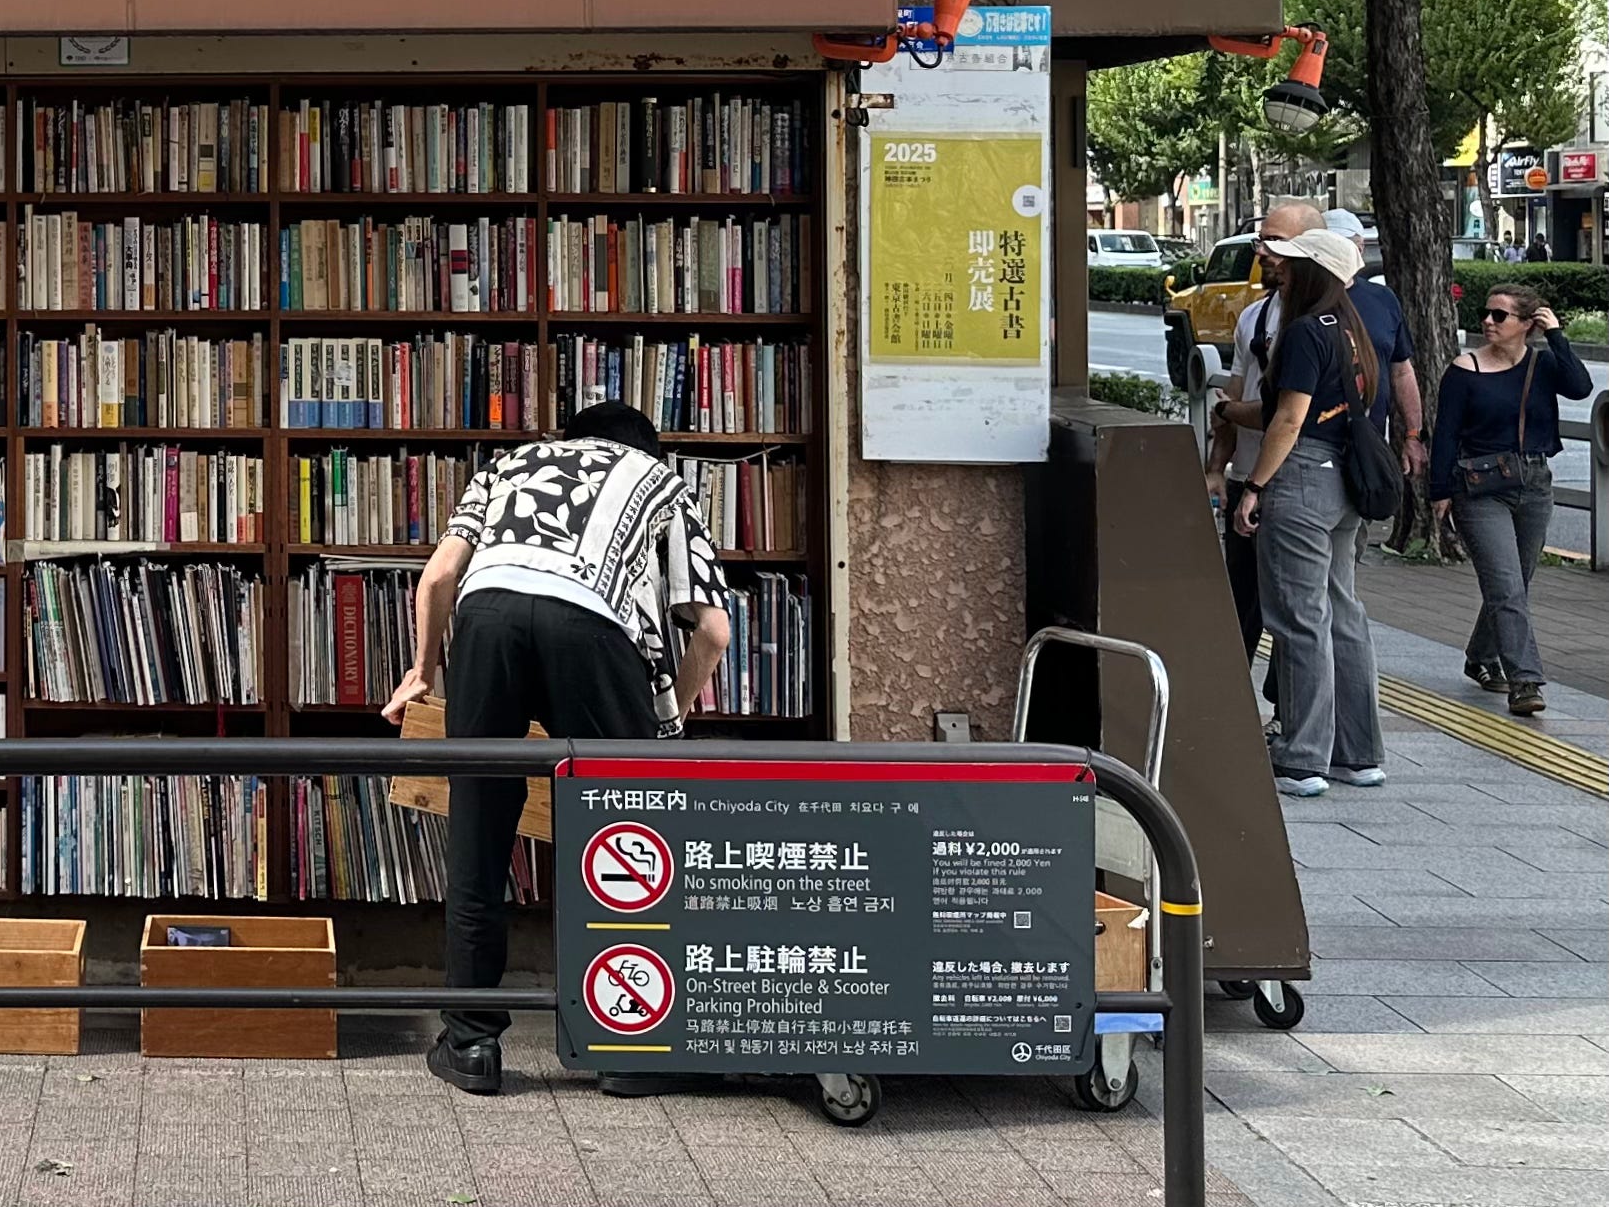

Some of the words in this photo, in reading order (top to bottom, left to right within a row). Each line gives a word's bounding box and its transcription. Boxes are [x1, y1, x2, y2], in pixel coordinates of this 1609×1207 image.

[884, 143, 936, 162] 2025
[968, 230, 995, 312] 即売展
[999, 230, 1026, 339] 特選古書
[343, 606, 358, 681] DICTIONARY
[580, 789, 687, 810] 千代田区内
[694, 800, 706, 812] In
[710, 800, 762, 814] Chiyoda
[765, 800, 790, 815] City
[798, 802, 842, 813] 在千代田
[684, 841, 869, 871] 路上喫煙禁止
[932, 842, 962, 856] 過料
[933, 859, 950, 867] You
[952, 859, 968, 867] will
[970, 859, 981, 867] be
[984, 859, 1006, 867] fined
[1008, 859, 1032, 868] 2,000
[1034, 859, 1051, 867] Yen
[941, 870, 957, 878] you
[960, 868, 989, 876] violate
[991, 868, 1006, 876] this
[1009, 868, 1026, 876] rule
[684, 875, 704, 890] No
[710, 875, 773, 894] smoking
[777, 878, 795, 891] on
[799, 876, 823, 891] the
[827, 877, 871, 891] street
[684, 896, 778, 911] 道路禁止吸烟
[791, 896, 822, 911] 노상
[826, 896, 859, 912] 흡연
[864, 897, 895, 912] 금지
[685, 944, 868, 974] 路上駐輪禁止
[932, 961, 1070, 973] 違反した場合、撤去します
[686, 978, 757, 994] On-Street
[762, 979, 813, 997] Bicycle
[818, 980, 829, 994] &
[834, 980, 890, 995] Scooter
[686, 998, 742, 1017] Parking
[747, 998, 823, 1015] Prohibited
[686, 1039, 720, 1054] 자전거
[740, 1039, 773, 1054] 원동기
[777, 1040, 800, 1054] 장치
[804, 1040, 839, 1055] 자전거
[842, 1040, 865, 1056] 노상
[869, 1040, 892, 1056] 주차
[896, 1040, 919, 1056] 금지
[1035, 1045, 1071, 1054] 千代田区
